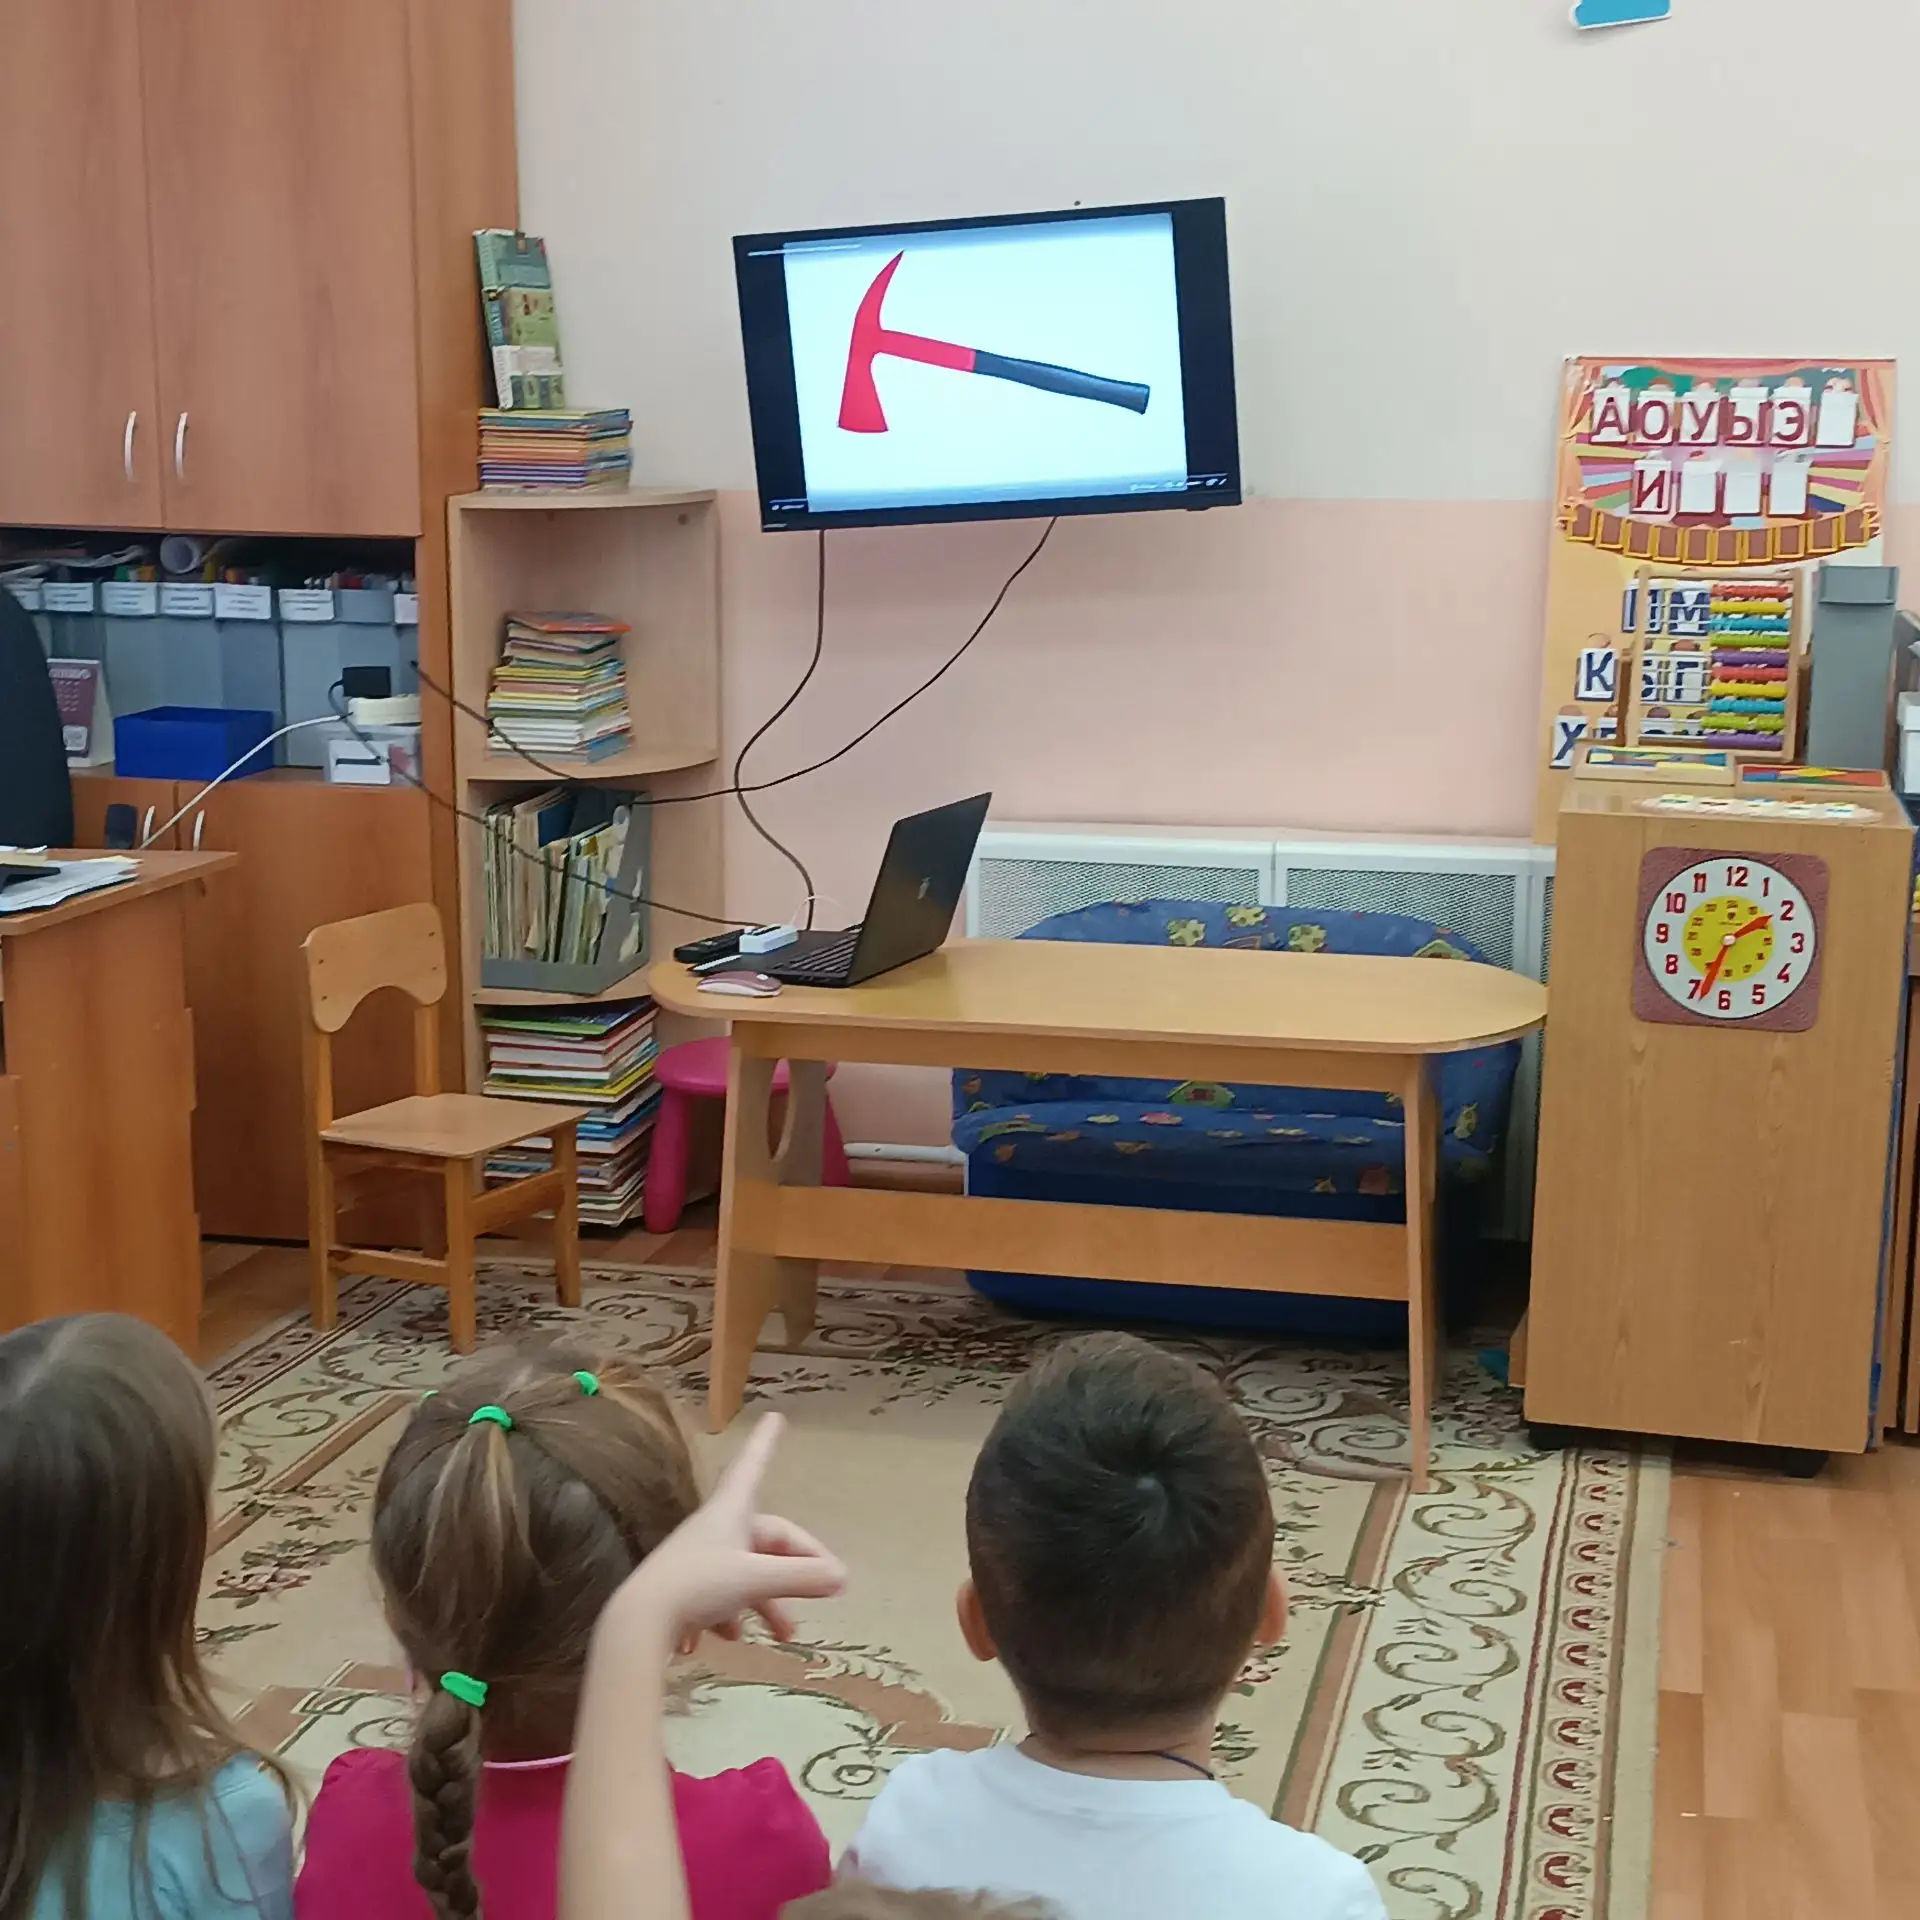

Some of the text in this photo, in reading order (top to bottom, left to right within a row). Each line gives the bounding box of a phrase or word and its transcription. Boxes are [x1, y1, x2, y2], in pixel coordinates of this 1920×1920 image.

[1634, 469, 1666, 510] И
[1585, 651, 1615, 692] К
[1693, 873, 1707, 893] 11
[1726, 866, 1749, 887] 12
[1762, 877, 1770, 897] 1
[1665, 892, 1687, 914] 10
[1780, 900, 1795, 921] 2
[1656, 923, 1669, 943] 9
[1790, 932, 1804, 953] 3
[1665, 954, 1679, 975] 8
[1777, 963, 1792, 983] 4
[1687, 979, 1702, 1000] 7
[1751, 984, 1766, 1005] 5
[1718, 990, 1731, 1011] 6
